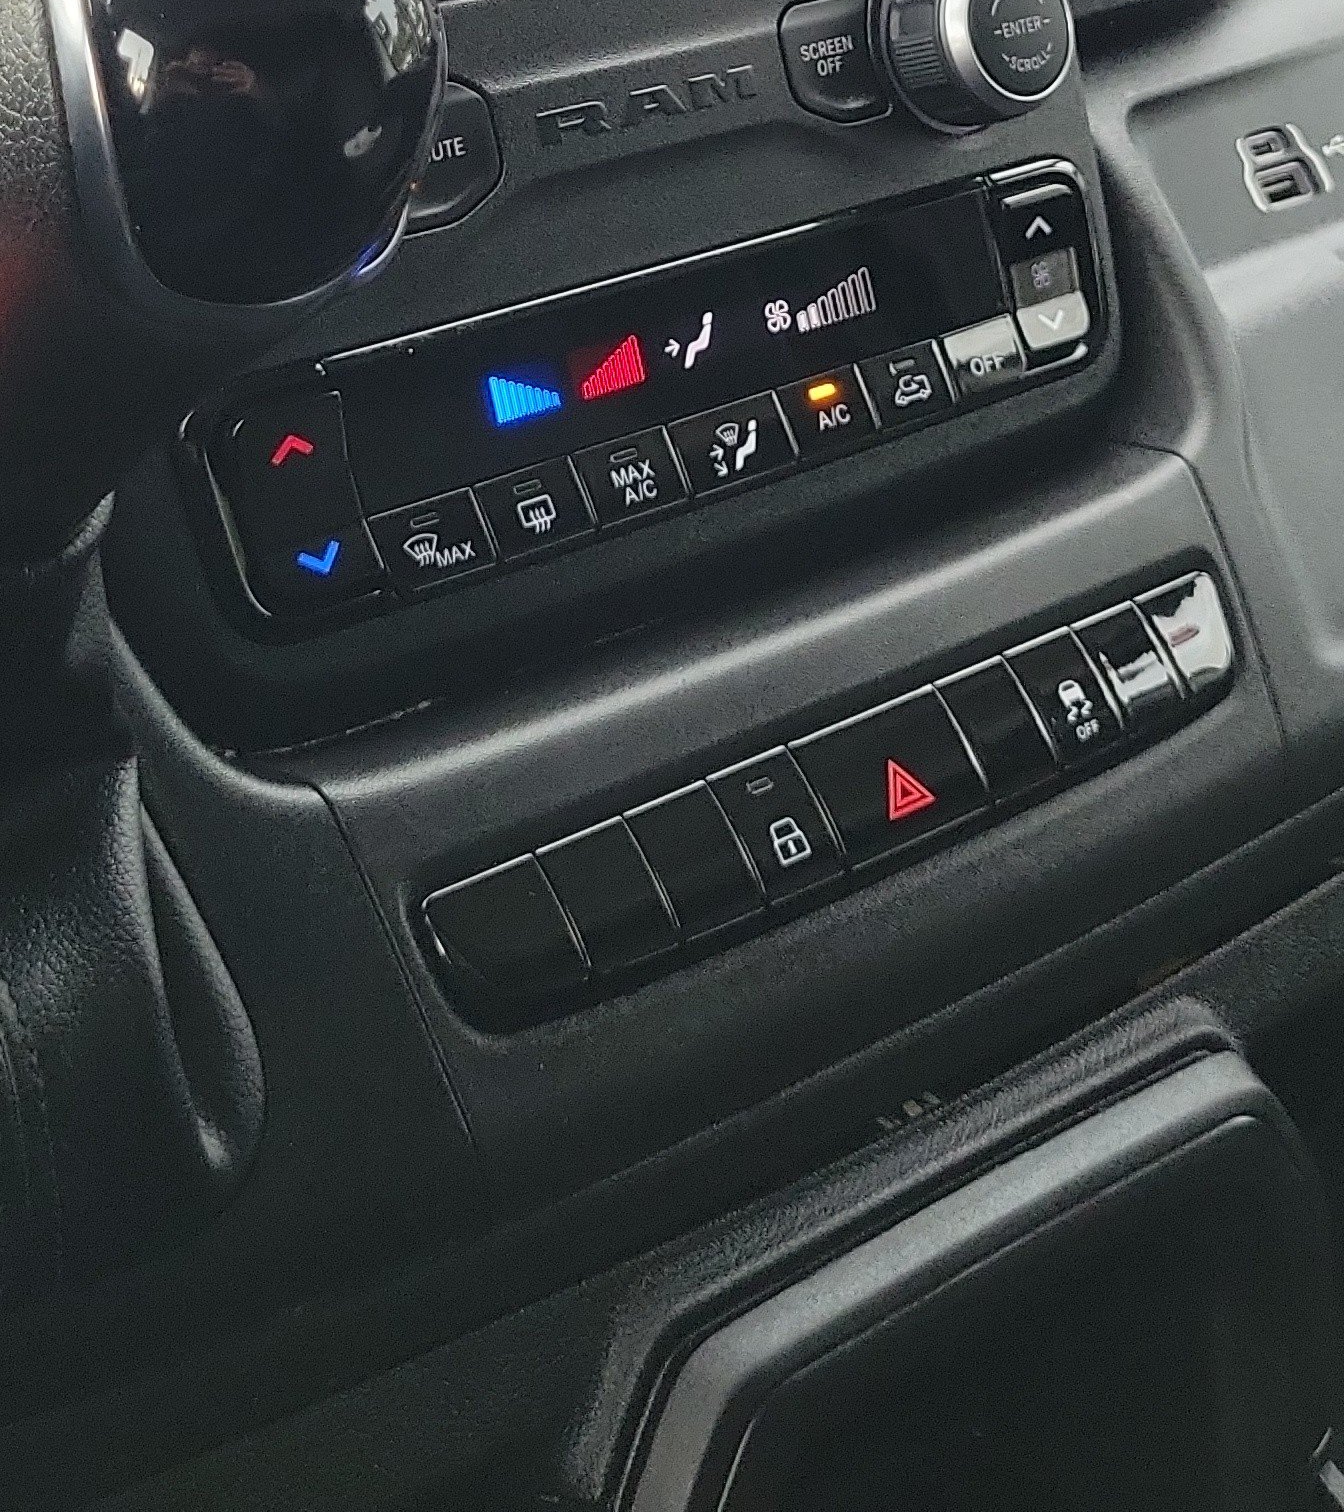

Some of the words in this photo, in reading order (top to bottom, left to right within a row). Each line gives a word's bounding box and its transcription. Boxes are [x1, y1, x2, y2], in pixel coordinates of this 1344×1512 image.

[1001, 15, 1041, 39] ENTER
[799, 34, 854, 62] SCREEN
[1009, 49, 1051, 72] SCROLL
[817, 55, 843, 77] OFF
[534, 64, 757, 148] RAM
[428, 136, 467, 163] UTE
[969, 354, 1005, 377] OFF
[818, 403, 851, 431] A/C
[610, 459, 656, 488] MAX
[625, 479, 657, 507] A/C
[435, 540, 476, 568] MAX
[1076, 718, 1100, 742] OFF
